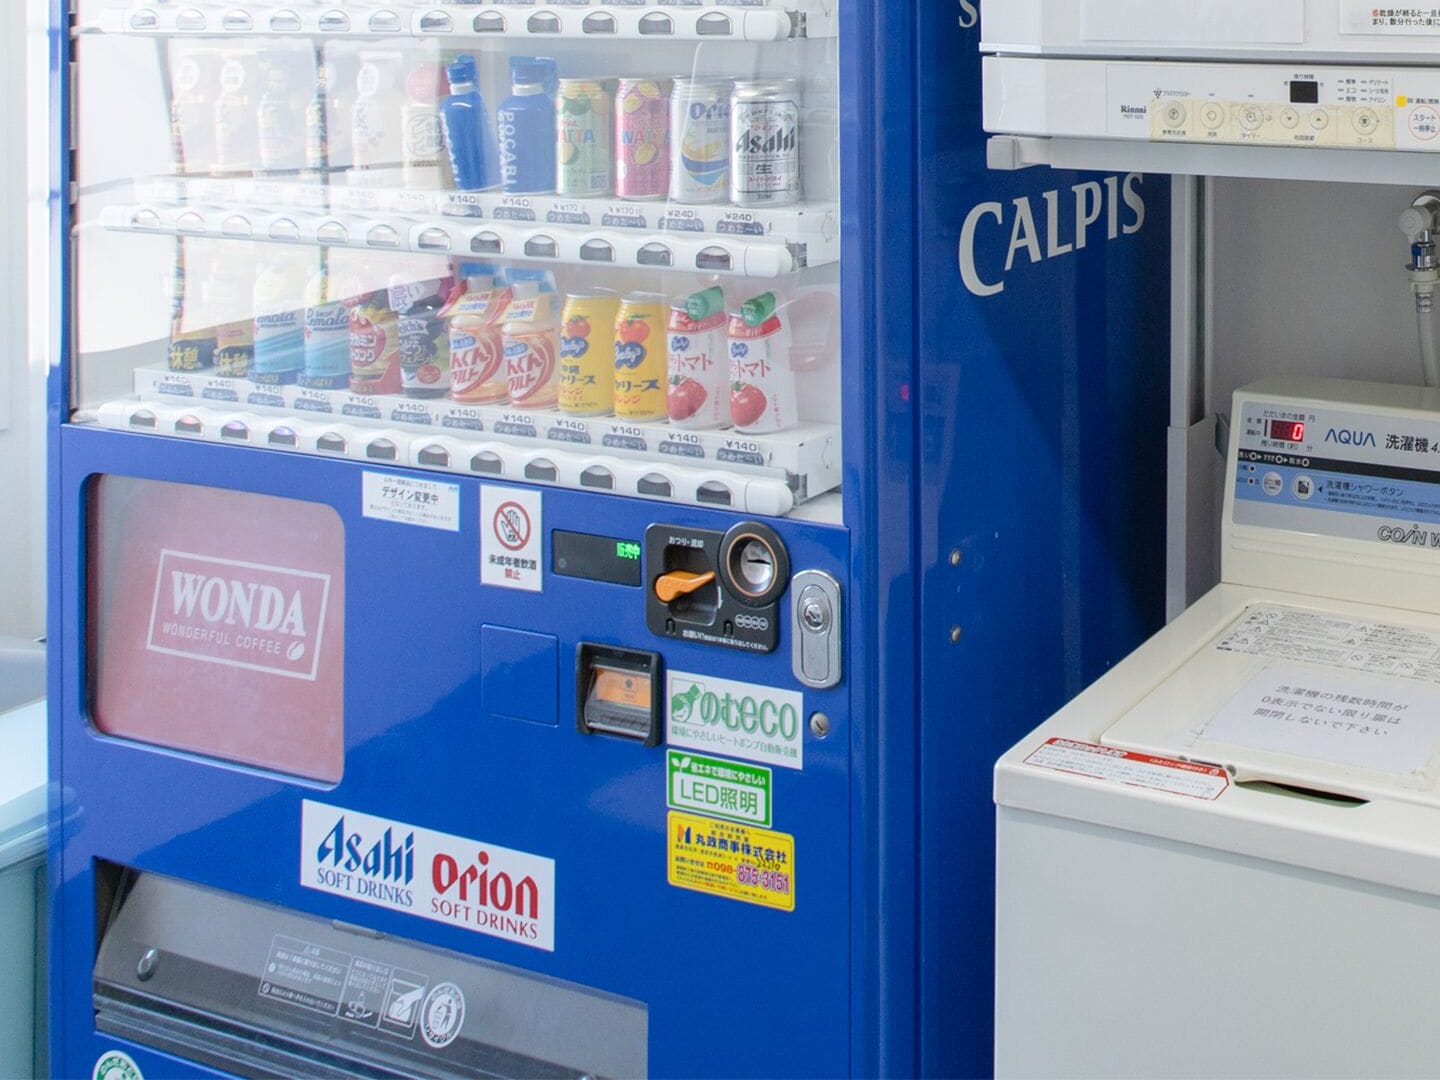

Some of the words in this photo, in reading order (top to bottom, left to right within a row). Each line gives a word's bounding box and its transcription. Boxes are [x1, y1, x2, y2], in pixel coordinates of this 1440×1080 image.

[1120, 105, 1147, 114] Rinnai
[736, 126, 795, 154] Asahi
[502, 112, 518, 185] POCARI
[756, 163, 773, 175] 生
[449, 194, 476, 204] ¥140
[502, 198, 529, 207] ¥140
[668, 209, 693, 219] ¥240
[725, 212, 752, 221] ¥240
[958, 172, 1145, 296] CALPIS
[165, 375, 188, 384] ¥140
[255, 385, 279, 394] ¥140
[302, 390, 327, 400] ¥140
[349, 396, 374, 405] ¥140
[399, 403, 425, 412] ¥140
[450, 409, 476, 418] ¥140
[503, 414, 531, 423] ¥140
[557, 419, 585, 431] ¥140
[612, 426, 641, 436] ¥140
[1292, 424, 1304, 440] 0
[668, 433, 698, 443] ¥140
[725, 440, 757, 451] ¥140
[1324, 428, 1376, 448] AQUA
[1385, 433, 1429, 454] 洗濯機
[381, 485, 439, 505] デザイン変更中
[1377, 523, 1428, 546] COIN
[616, 542, 641, 560] 販売中
[488, 554, 537, 570] 未成年者飲酒
[171, 570, 306, 637] WONDA
[162, 621, 231, 646] WONDERFUL
[235, 635, 281, 655] COFFEE
[1276, 684, 1409, 712] 洗濯機の残数時間が
[700, 690, 799, 742] のむeco
[1261, 695, 1402, 725] 0表示でない限り扉は
[1253, 707, 1388, 736] 開閉しないで下さい
[670, 726, 798, 759] 環境にやさしいヒートポンプ自動販売機
[680, 779, 758, 816] LED照明
[317, 815, 414, 886] Asahi
[317, 867, 353, 891] SOFT
[356, 877, 413, 907] DRINKS
[431, 897, 471, 922] SOFT
[477, 909, 538, 939] DRINKS
